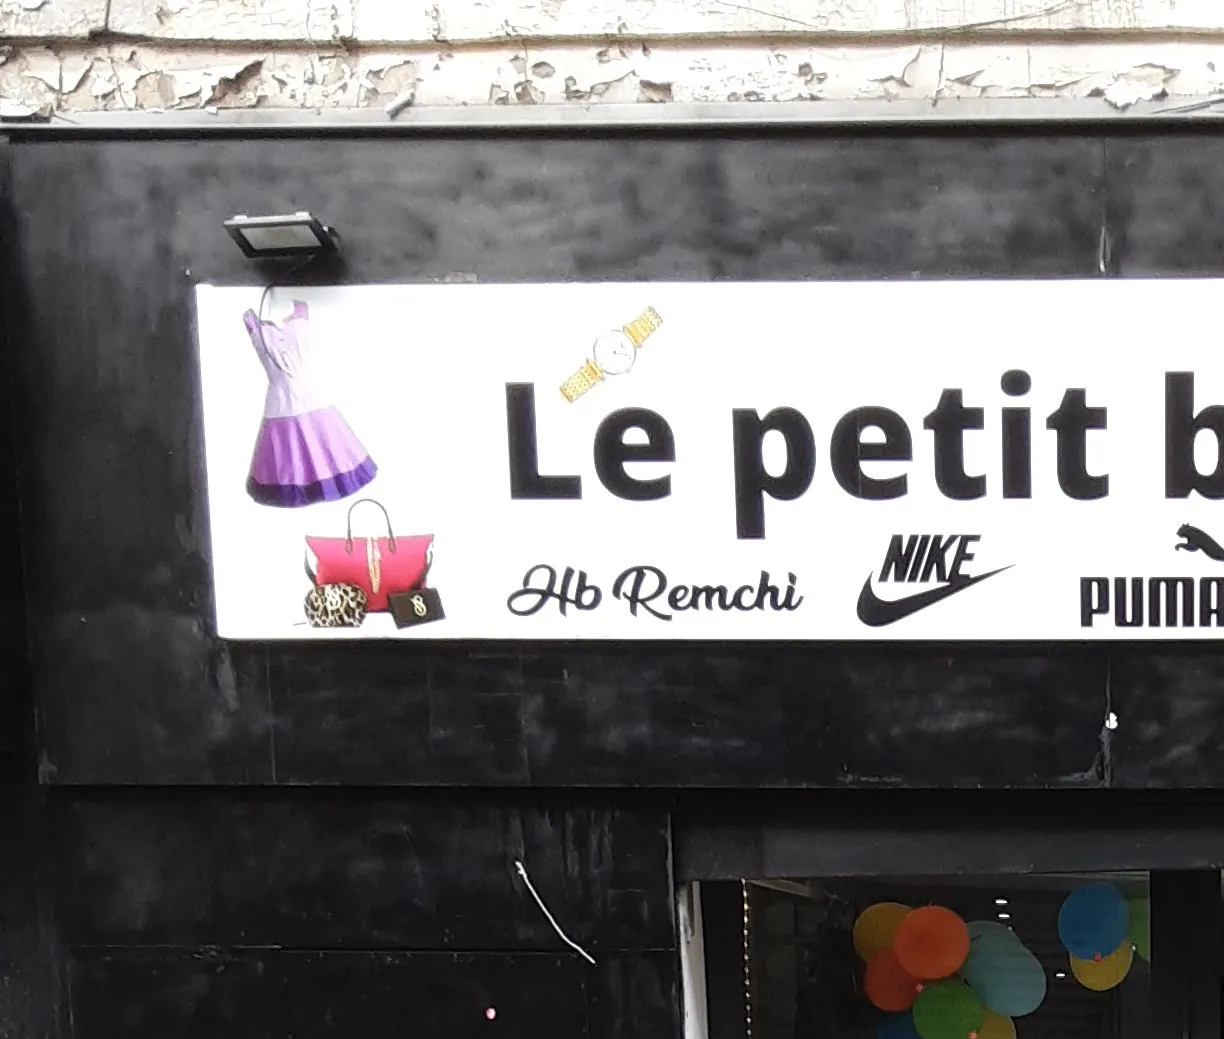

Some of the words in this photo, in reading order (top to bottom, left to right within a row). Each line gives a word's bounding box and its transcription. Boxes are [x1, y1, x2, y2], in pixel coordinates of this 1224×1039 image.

[505, 383, 676, 502] Le
[732, 369, 1109, 540] petit
[878, 534, 982, 583] NIKE
[612, 565, 804, 622] Remchi
